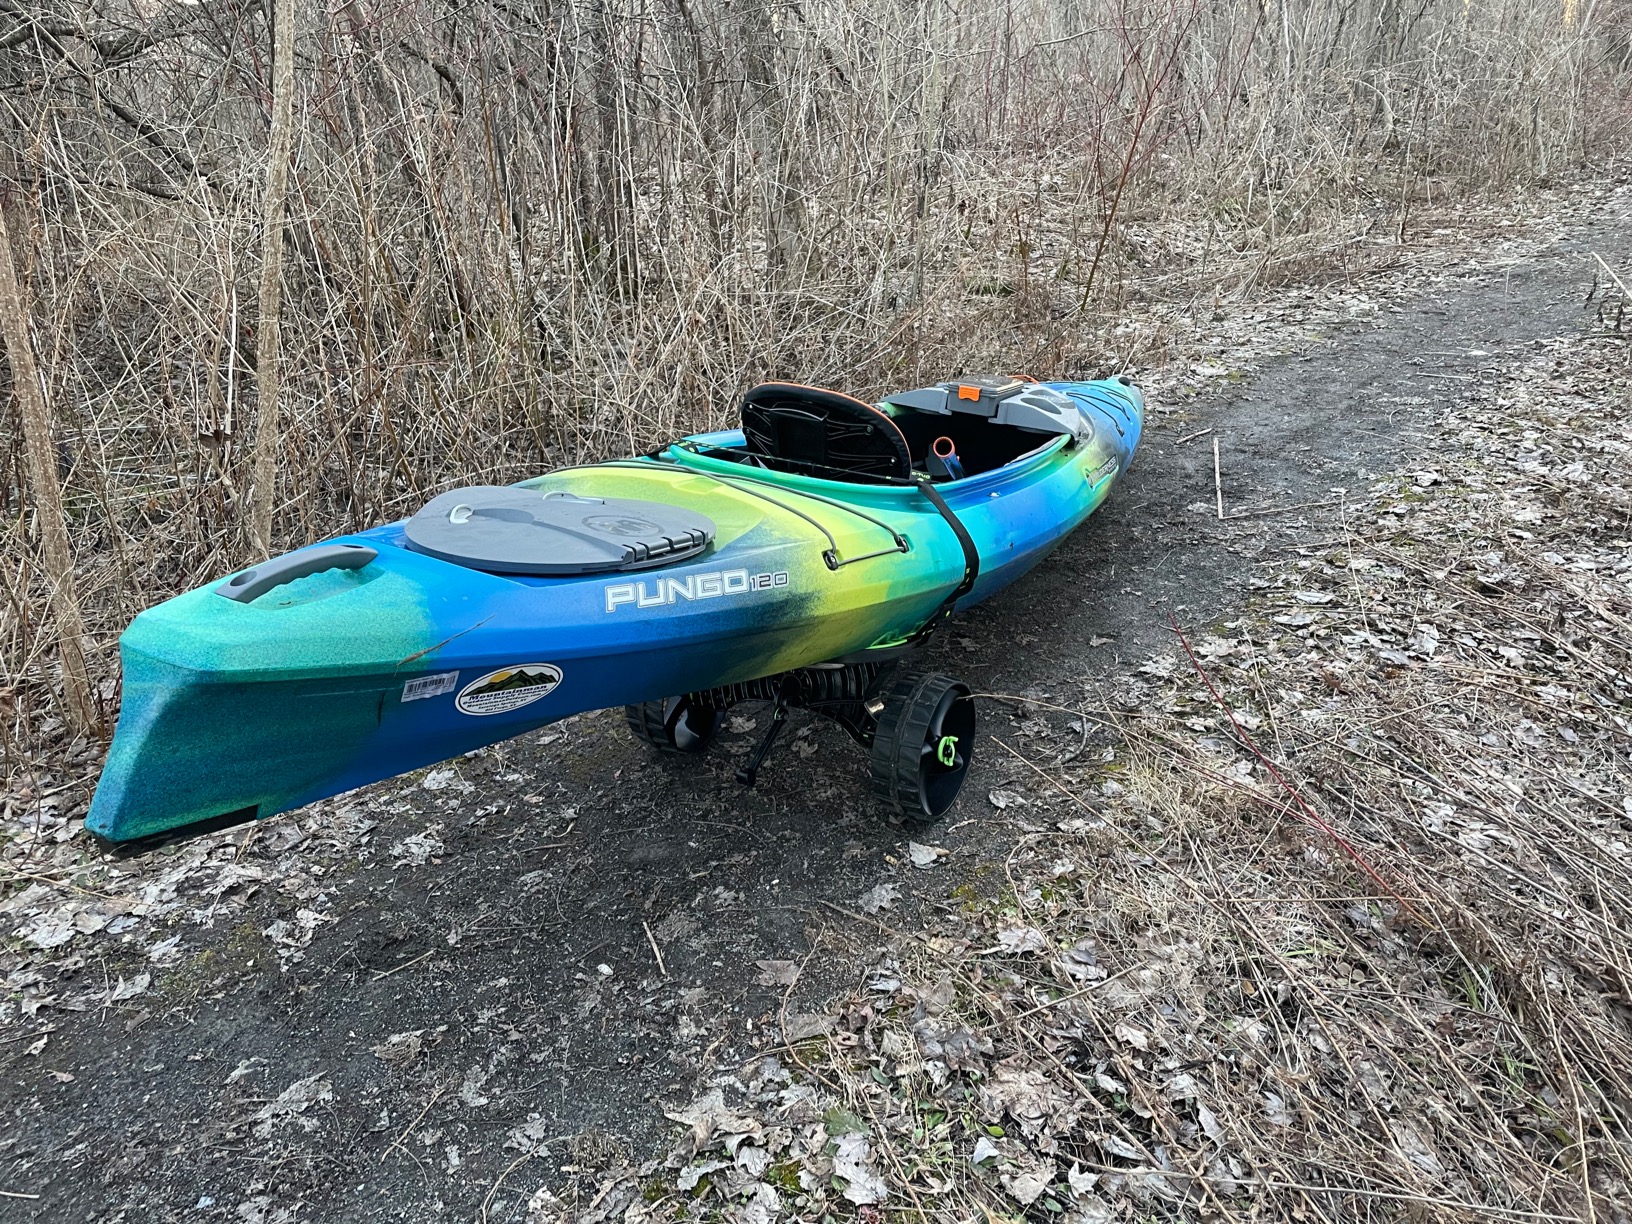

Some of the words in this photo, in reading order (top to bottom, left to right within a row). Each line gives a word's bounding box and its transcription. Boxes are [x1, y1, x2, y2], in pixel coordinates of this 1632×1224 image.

[605, 568, 749, 613] PUNGO
[750, 571, 789, 592] 120
[468, 685, 548, 701] Mountainman
